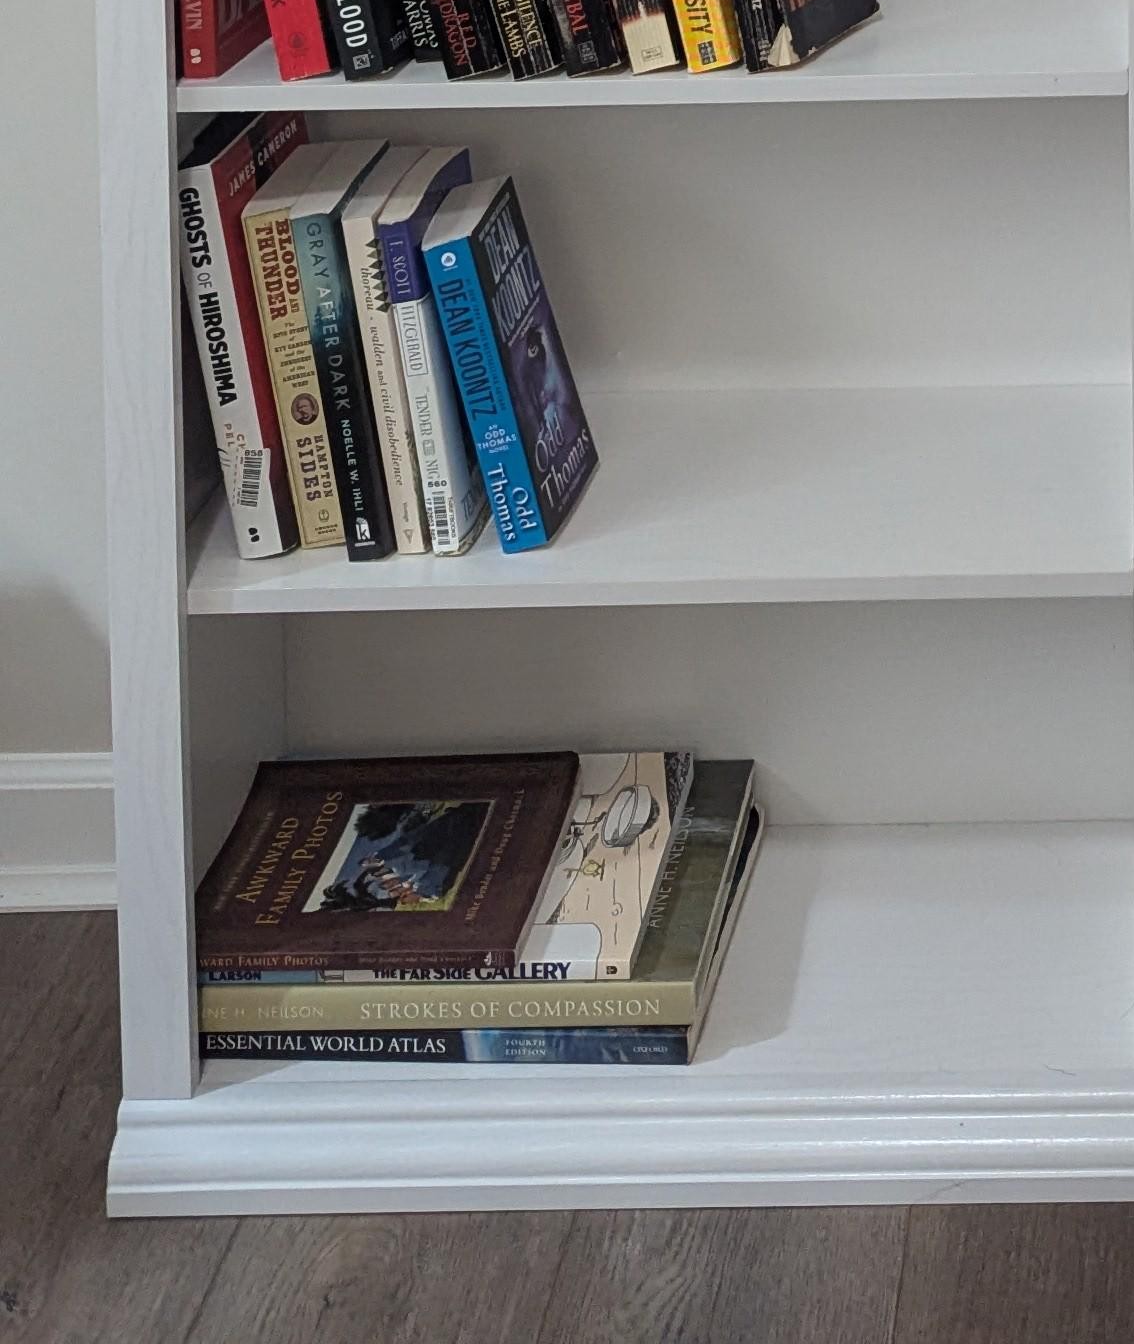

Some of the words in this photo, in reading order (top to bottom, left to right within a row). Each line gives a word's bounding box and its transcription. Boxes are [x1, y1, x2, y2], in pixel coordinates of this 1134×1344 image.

[177, 187, 211, 270] GHOSTS
[306, 223, 330, 278] GRAY
[198, 272, 212, 290] OF
[440, 279, 469, 337] DEAN
[316, 287, 341, 349] AFTER
[199, 291, 238, 407] HIROSHIMA
[327, 355, 351, 410] DARK
[454, 337, 497, 421] KOONTZ
[360, 1002, 463, 1019] STROKES
[470, 1001, 500, 1018] OF
[508, 998, 660, 1017] COMPASSION
[207, 1034, 306, 1052] ESSENTIAL
[310, 1034, 383, 1053] WORLD
[388, 1037, 446, 1054] ATLAS
